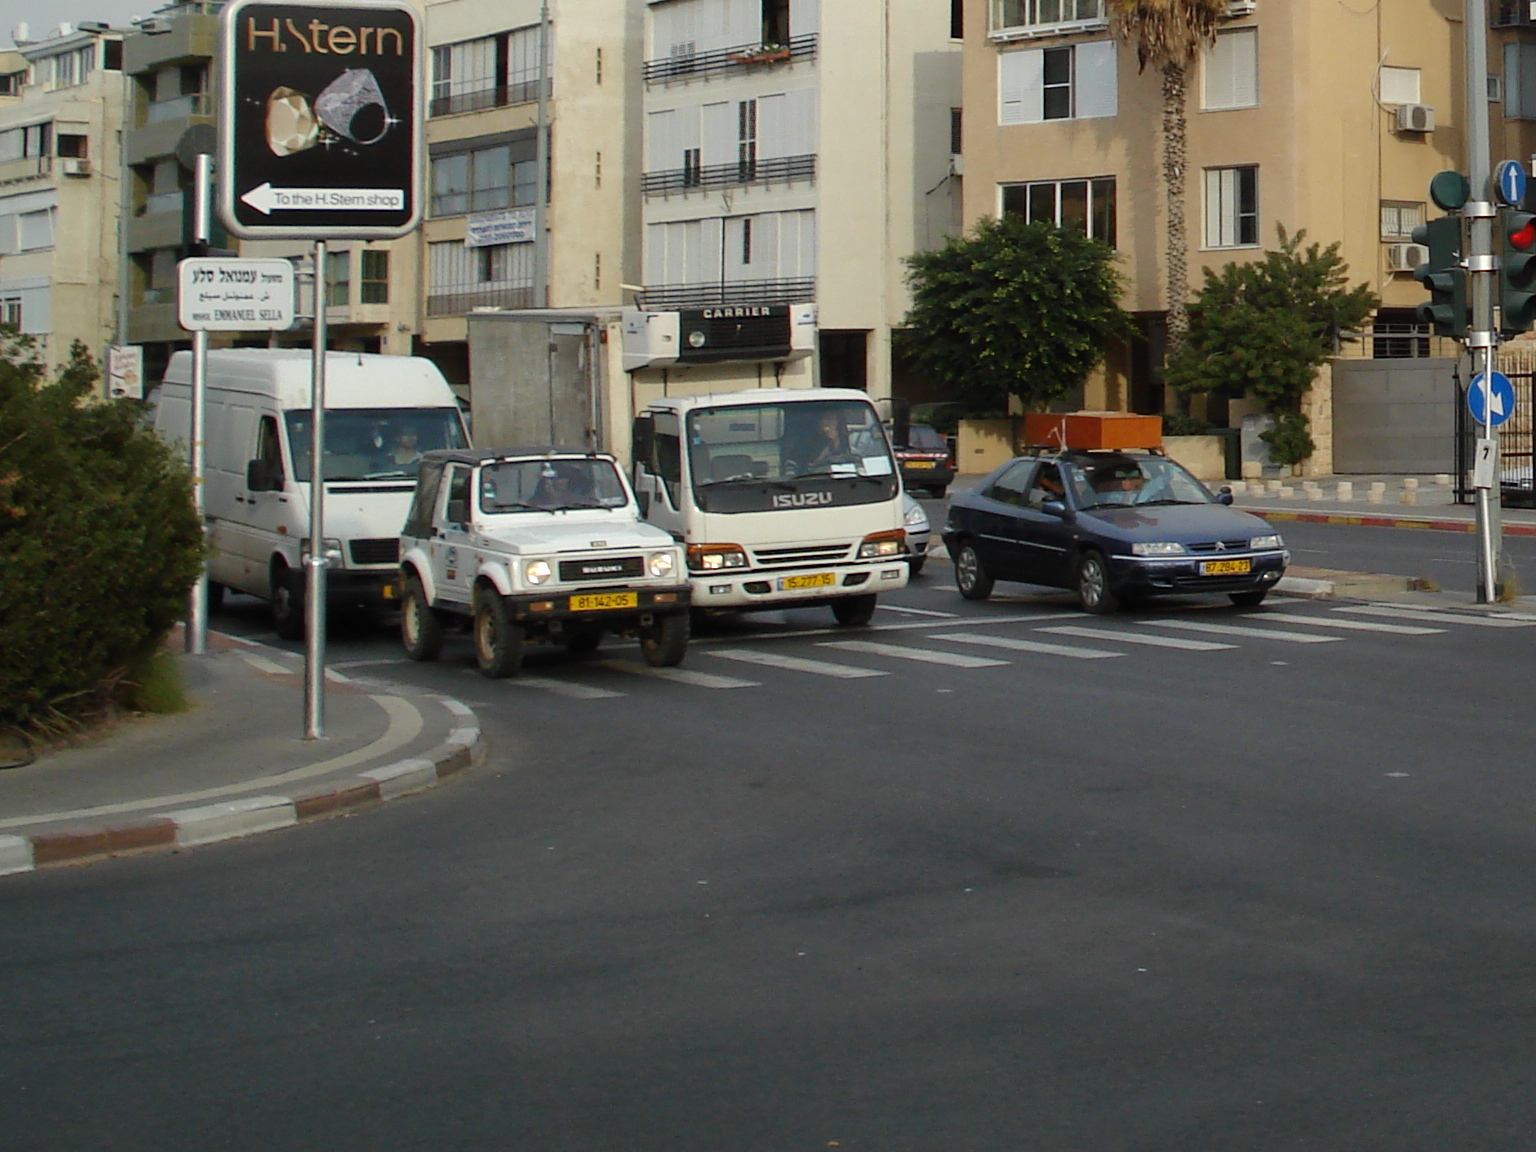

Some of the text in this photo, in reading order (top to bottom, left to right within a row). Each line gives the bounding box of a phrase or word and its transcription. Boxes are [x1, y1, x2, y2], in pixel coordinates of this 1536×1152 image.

[248, 17, 402, 55] H.Stern
[275, 193, 399, 208] To the H.Stern shop
[193, 267, 215, 284] סלע
[219, 266, 257, 284] עמנואל
[214, 309, 256, 321] EMMANUEL
[259, 309, 282, 321] SELLA
[703, 306, 770, 319] CARRIER
[1483, 446, 1490, 460] 7
[772, 491, 833, 508] ISUZU
[578, 594, 629, 609] 81-142-05
